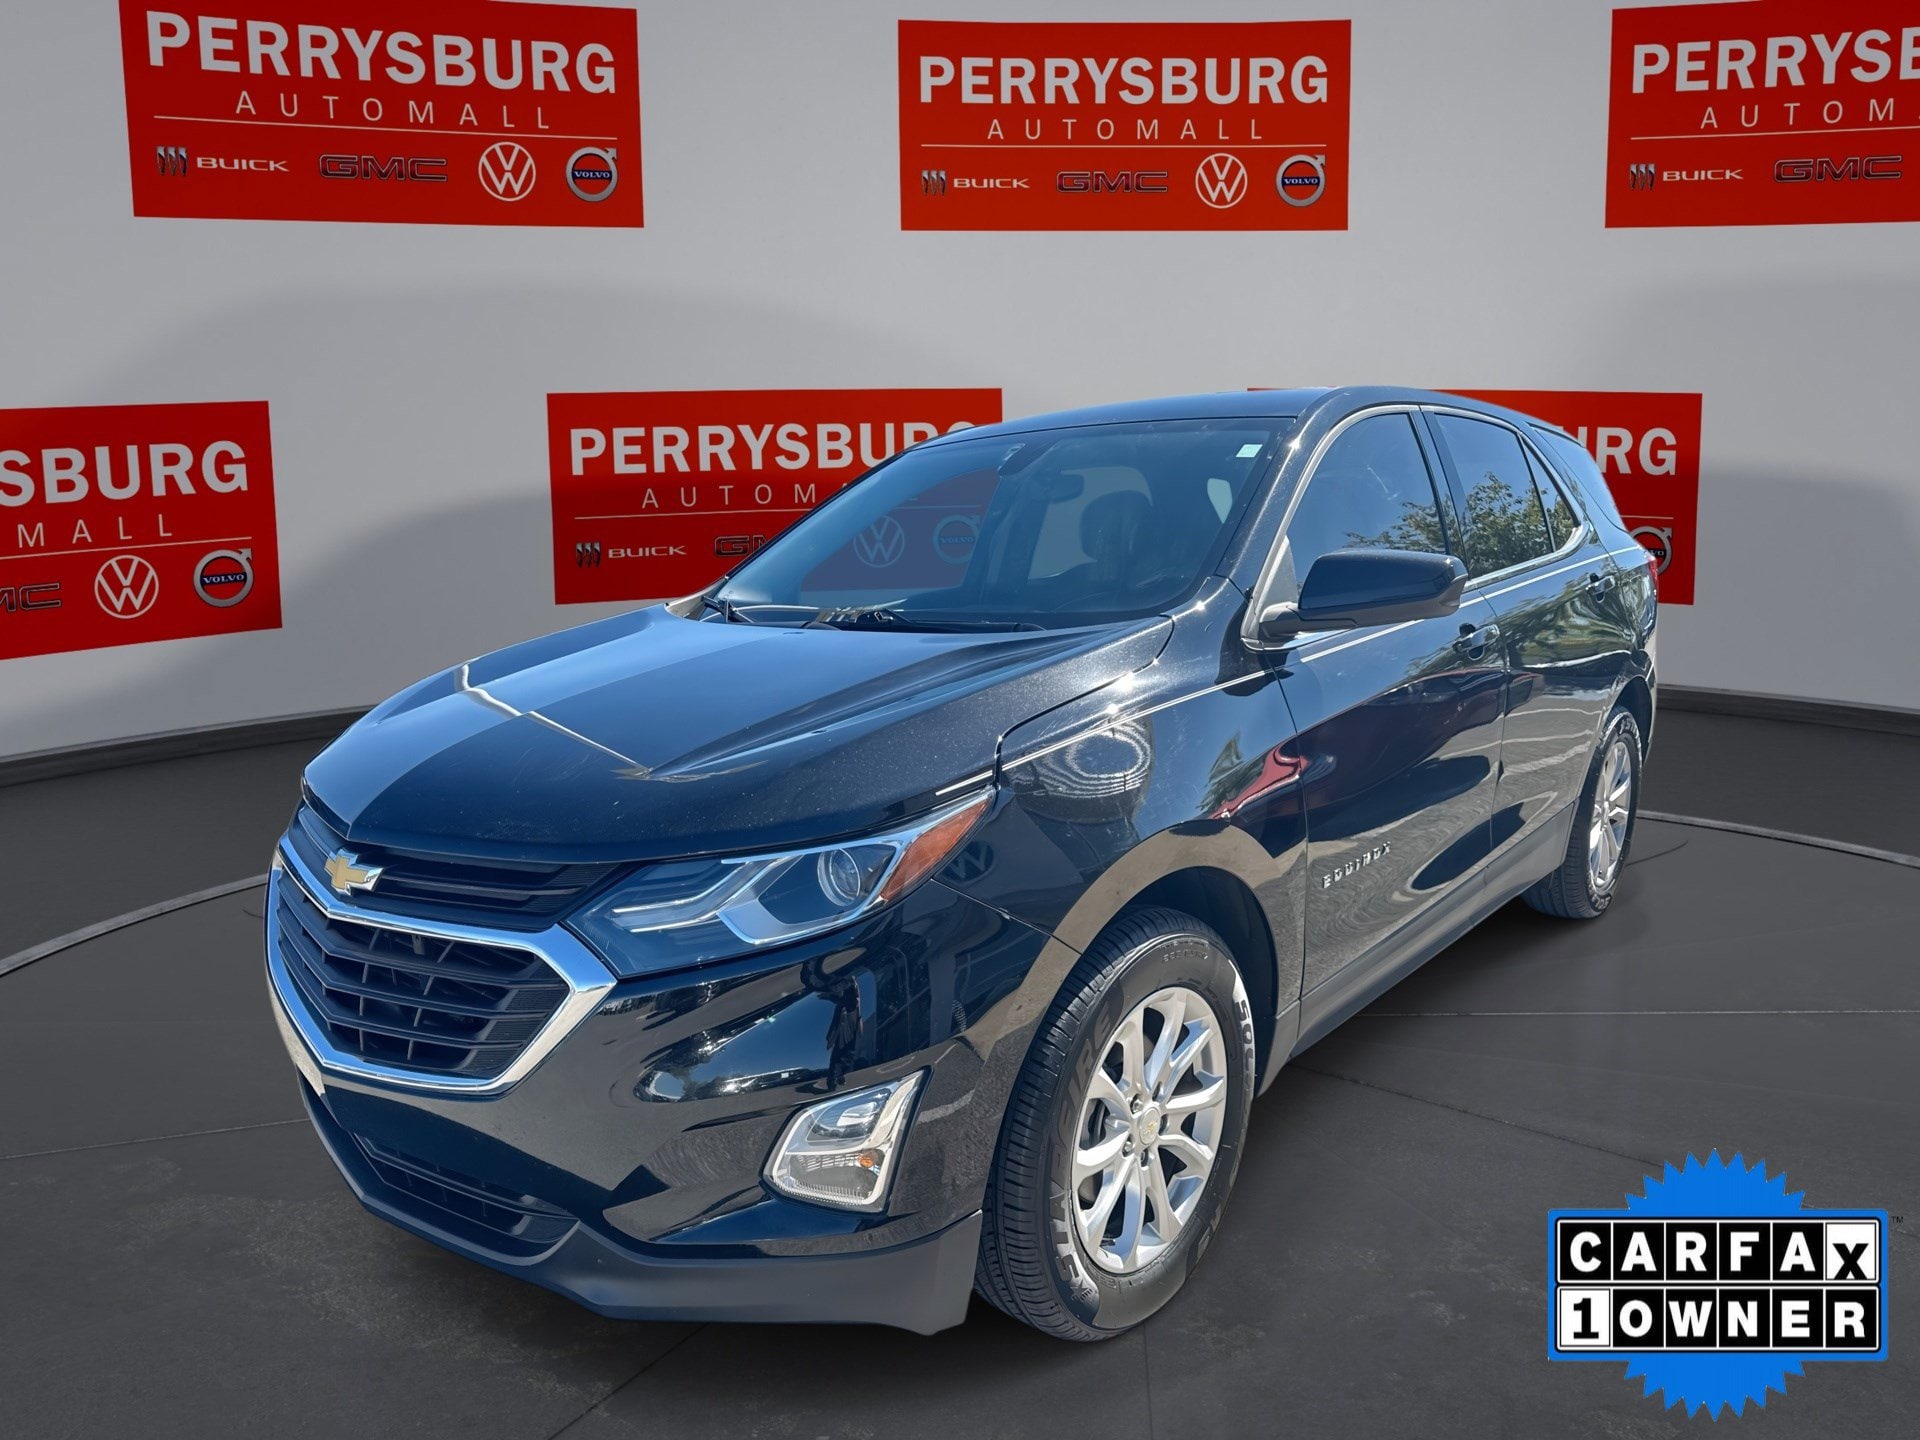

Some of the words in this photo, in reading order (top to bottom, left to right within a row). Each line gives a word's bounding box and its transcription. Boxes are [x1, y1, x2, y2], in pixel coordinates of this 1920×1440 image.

[146, 10, 616, 94] PERRYSBURG
[920, 55, 1328, 105] PERRYSBURG
[235, 90, 550, 130] AUTOMALL
[1700, 98, 1920, 129] AUTOM
[987, 118, 1262, 140] AUTOMALL
[196, 157, 289, 172] BUICK
[319, 154, 447, 182] GMC
[574, 170, 611, 180] VOLVO
[1662, 169, 1743, 182] BUICK
[1774, 155, 1902, 183] GMC
[953, 178, 1030, 189] BUICK
[1056, 170, 1168, 193] GMC
[570, 421, 975, 475] PERRYSBU
[642, 483, 847, 509] AUTOM
[608, 544, 687, 559] BUICK
[203, 574, 245, 584] VOLVO
[1322, 841, 1391, 889] EQUINOX
